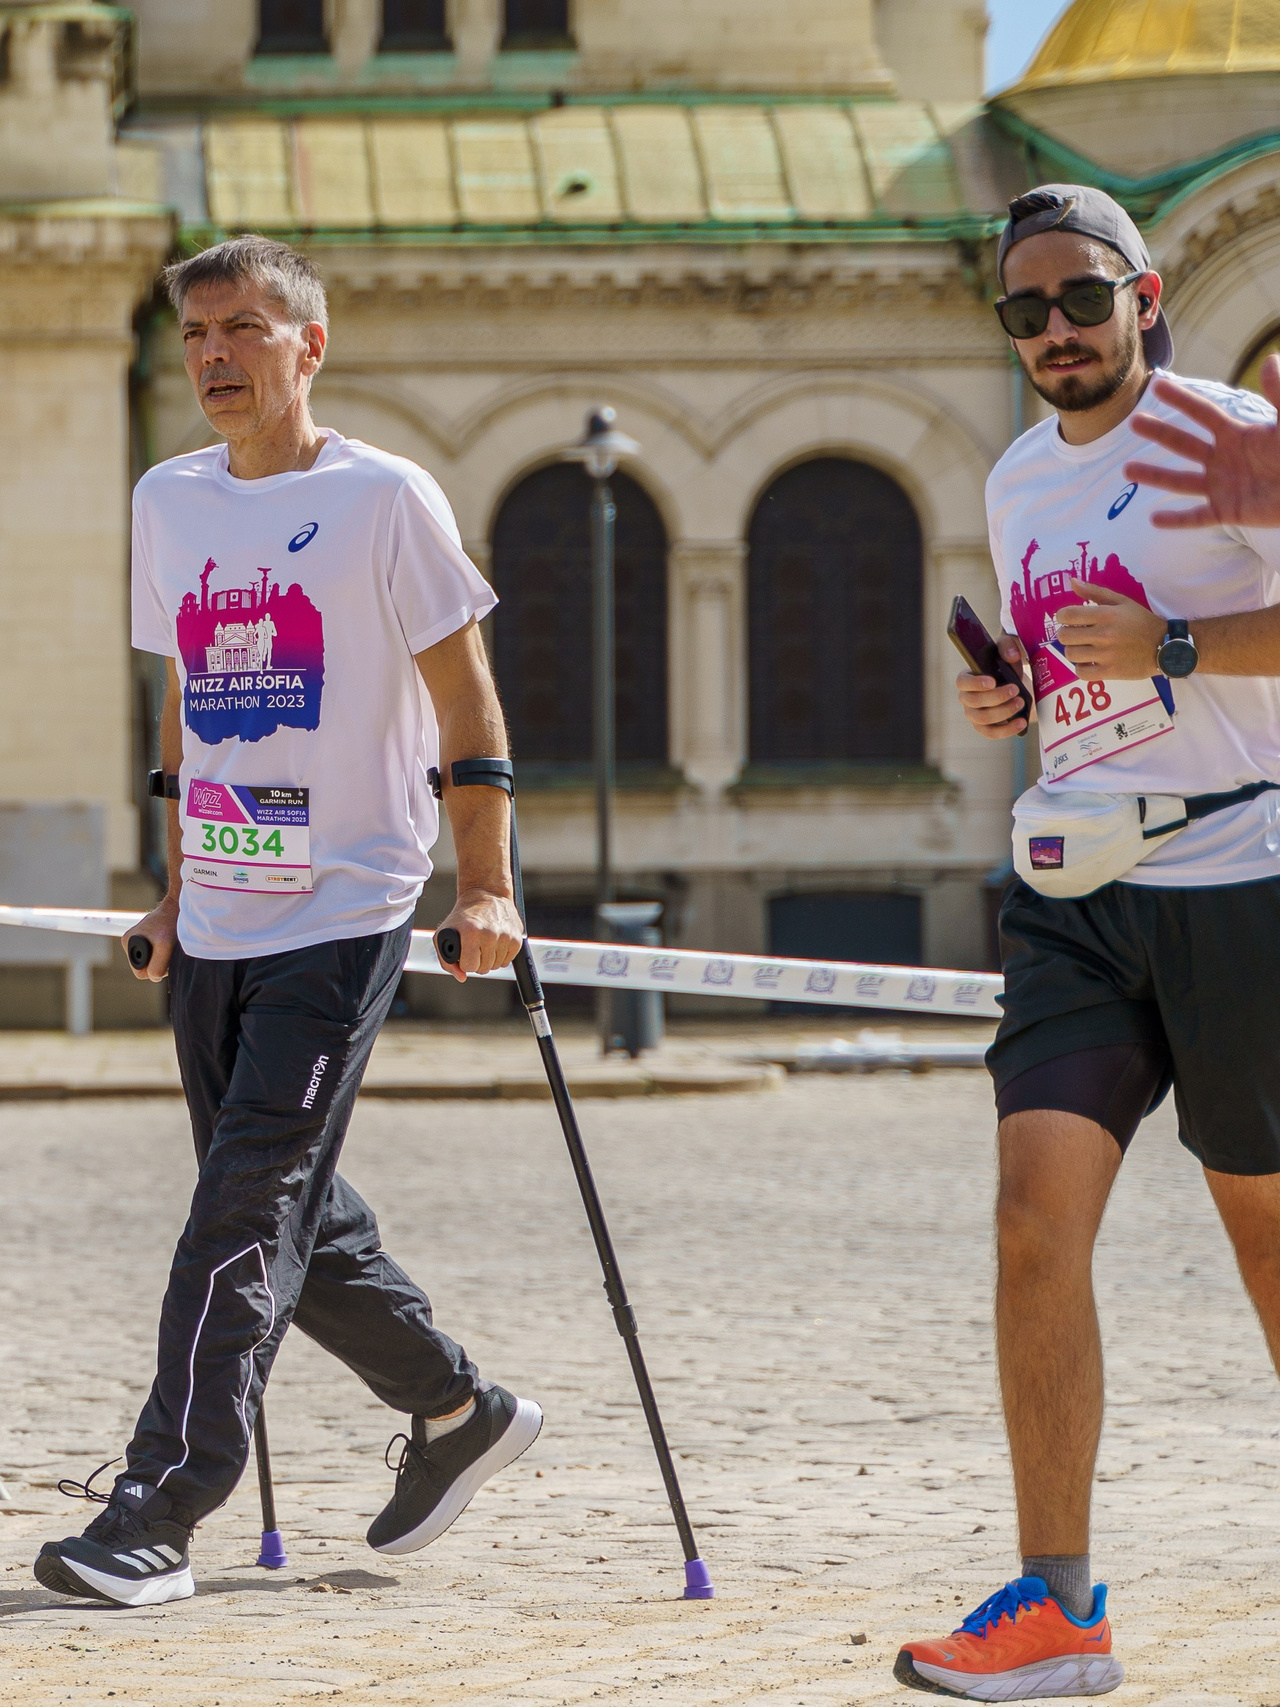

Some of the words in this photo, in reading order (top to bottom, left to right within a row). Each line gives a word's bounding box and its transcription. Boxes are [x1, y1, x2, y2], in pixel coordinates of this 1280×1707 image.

[189, 677, 225, 694] WIZZ
[228, 676, 254, 692] AIR
[255, 674, 304, 690] SOFIA
[189, 695, 261, 712] MARATHON
[267, 694, 306, 709] 2023
[1055, 680, 1111, 726] 428
[270, 790, 281, 798] 10
[201, 823, 284, 857] 3034
[301, 1054, 330, 1110] macron
